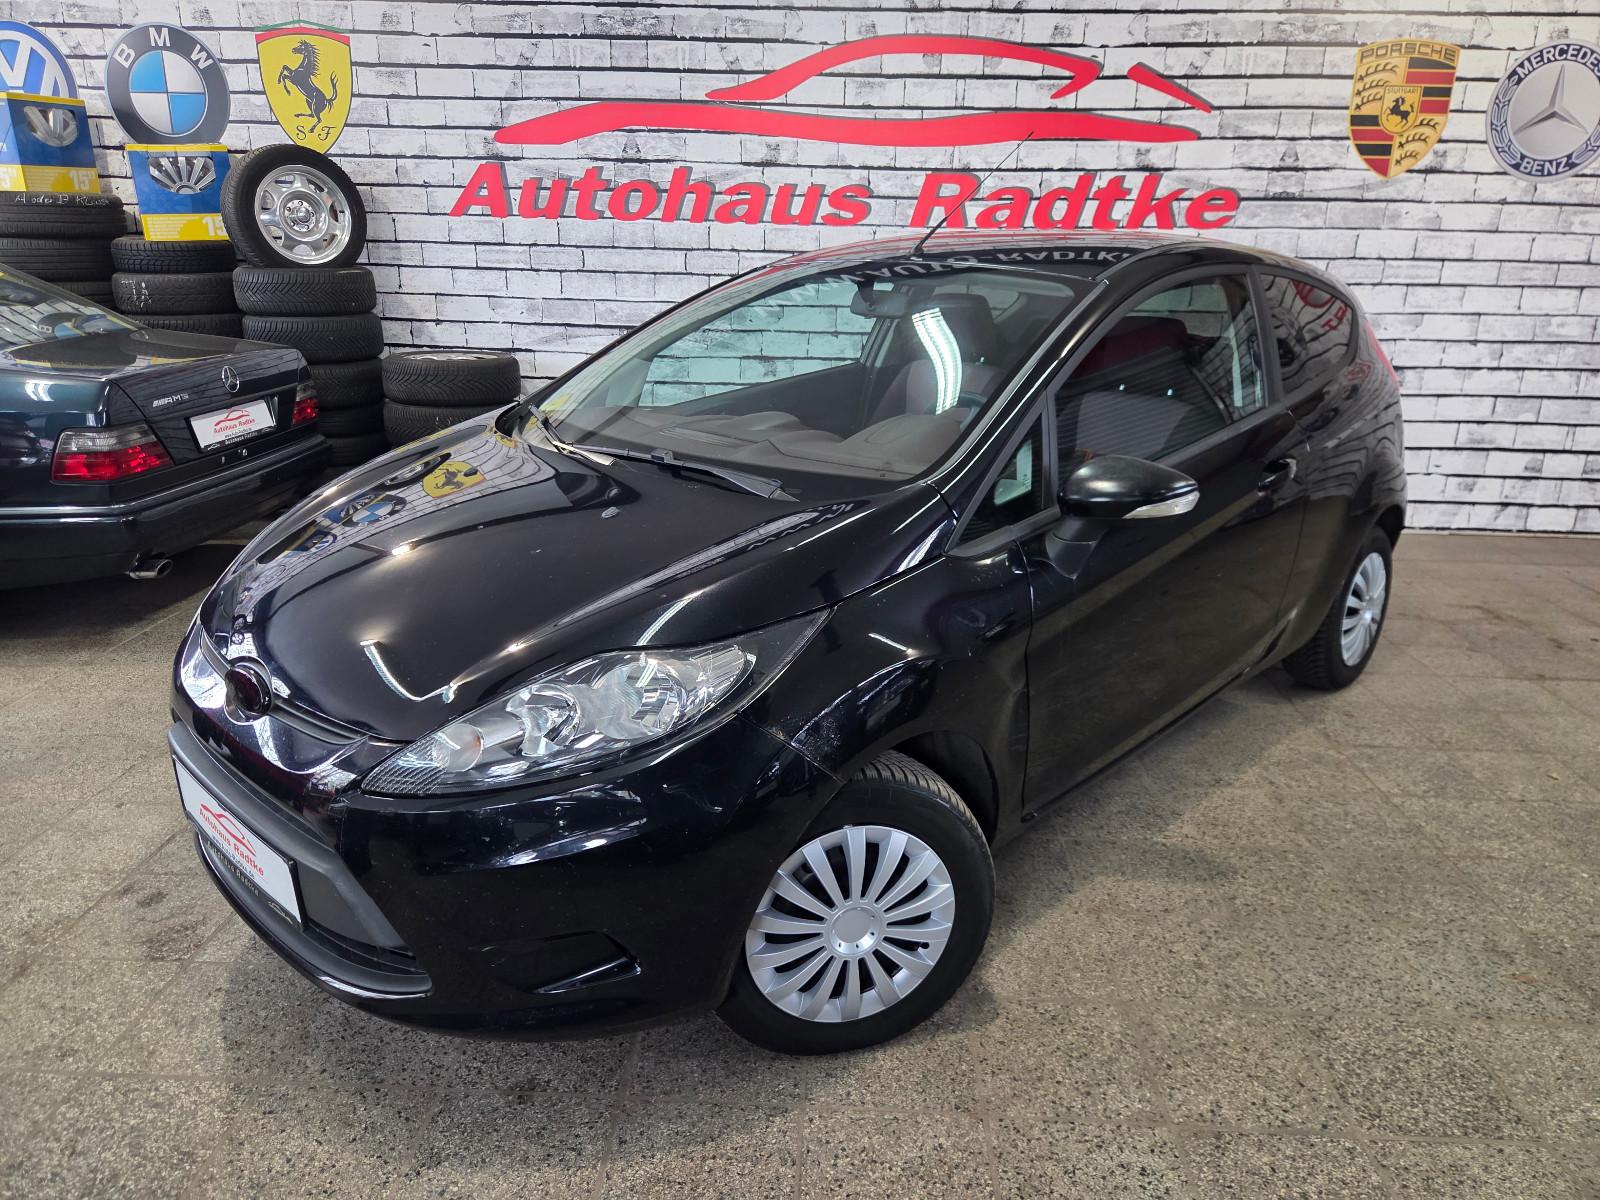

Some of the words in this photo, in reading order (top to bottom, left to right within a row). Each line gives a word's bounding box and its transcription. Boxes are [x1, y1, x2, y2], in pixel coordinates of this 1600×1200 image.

[113, 27, 214, 70] BMW
[1360, 42, 1457, 64] PORSCHE
[1519, 156, 1571, 176] BENZ
[448, 162, 871, 226] Autohaus
[909, 171, 1241, 231] Radtke
[199, 807, 231, 847] Autohaus
[233, 842, 265, 876] Radtke
